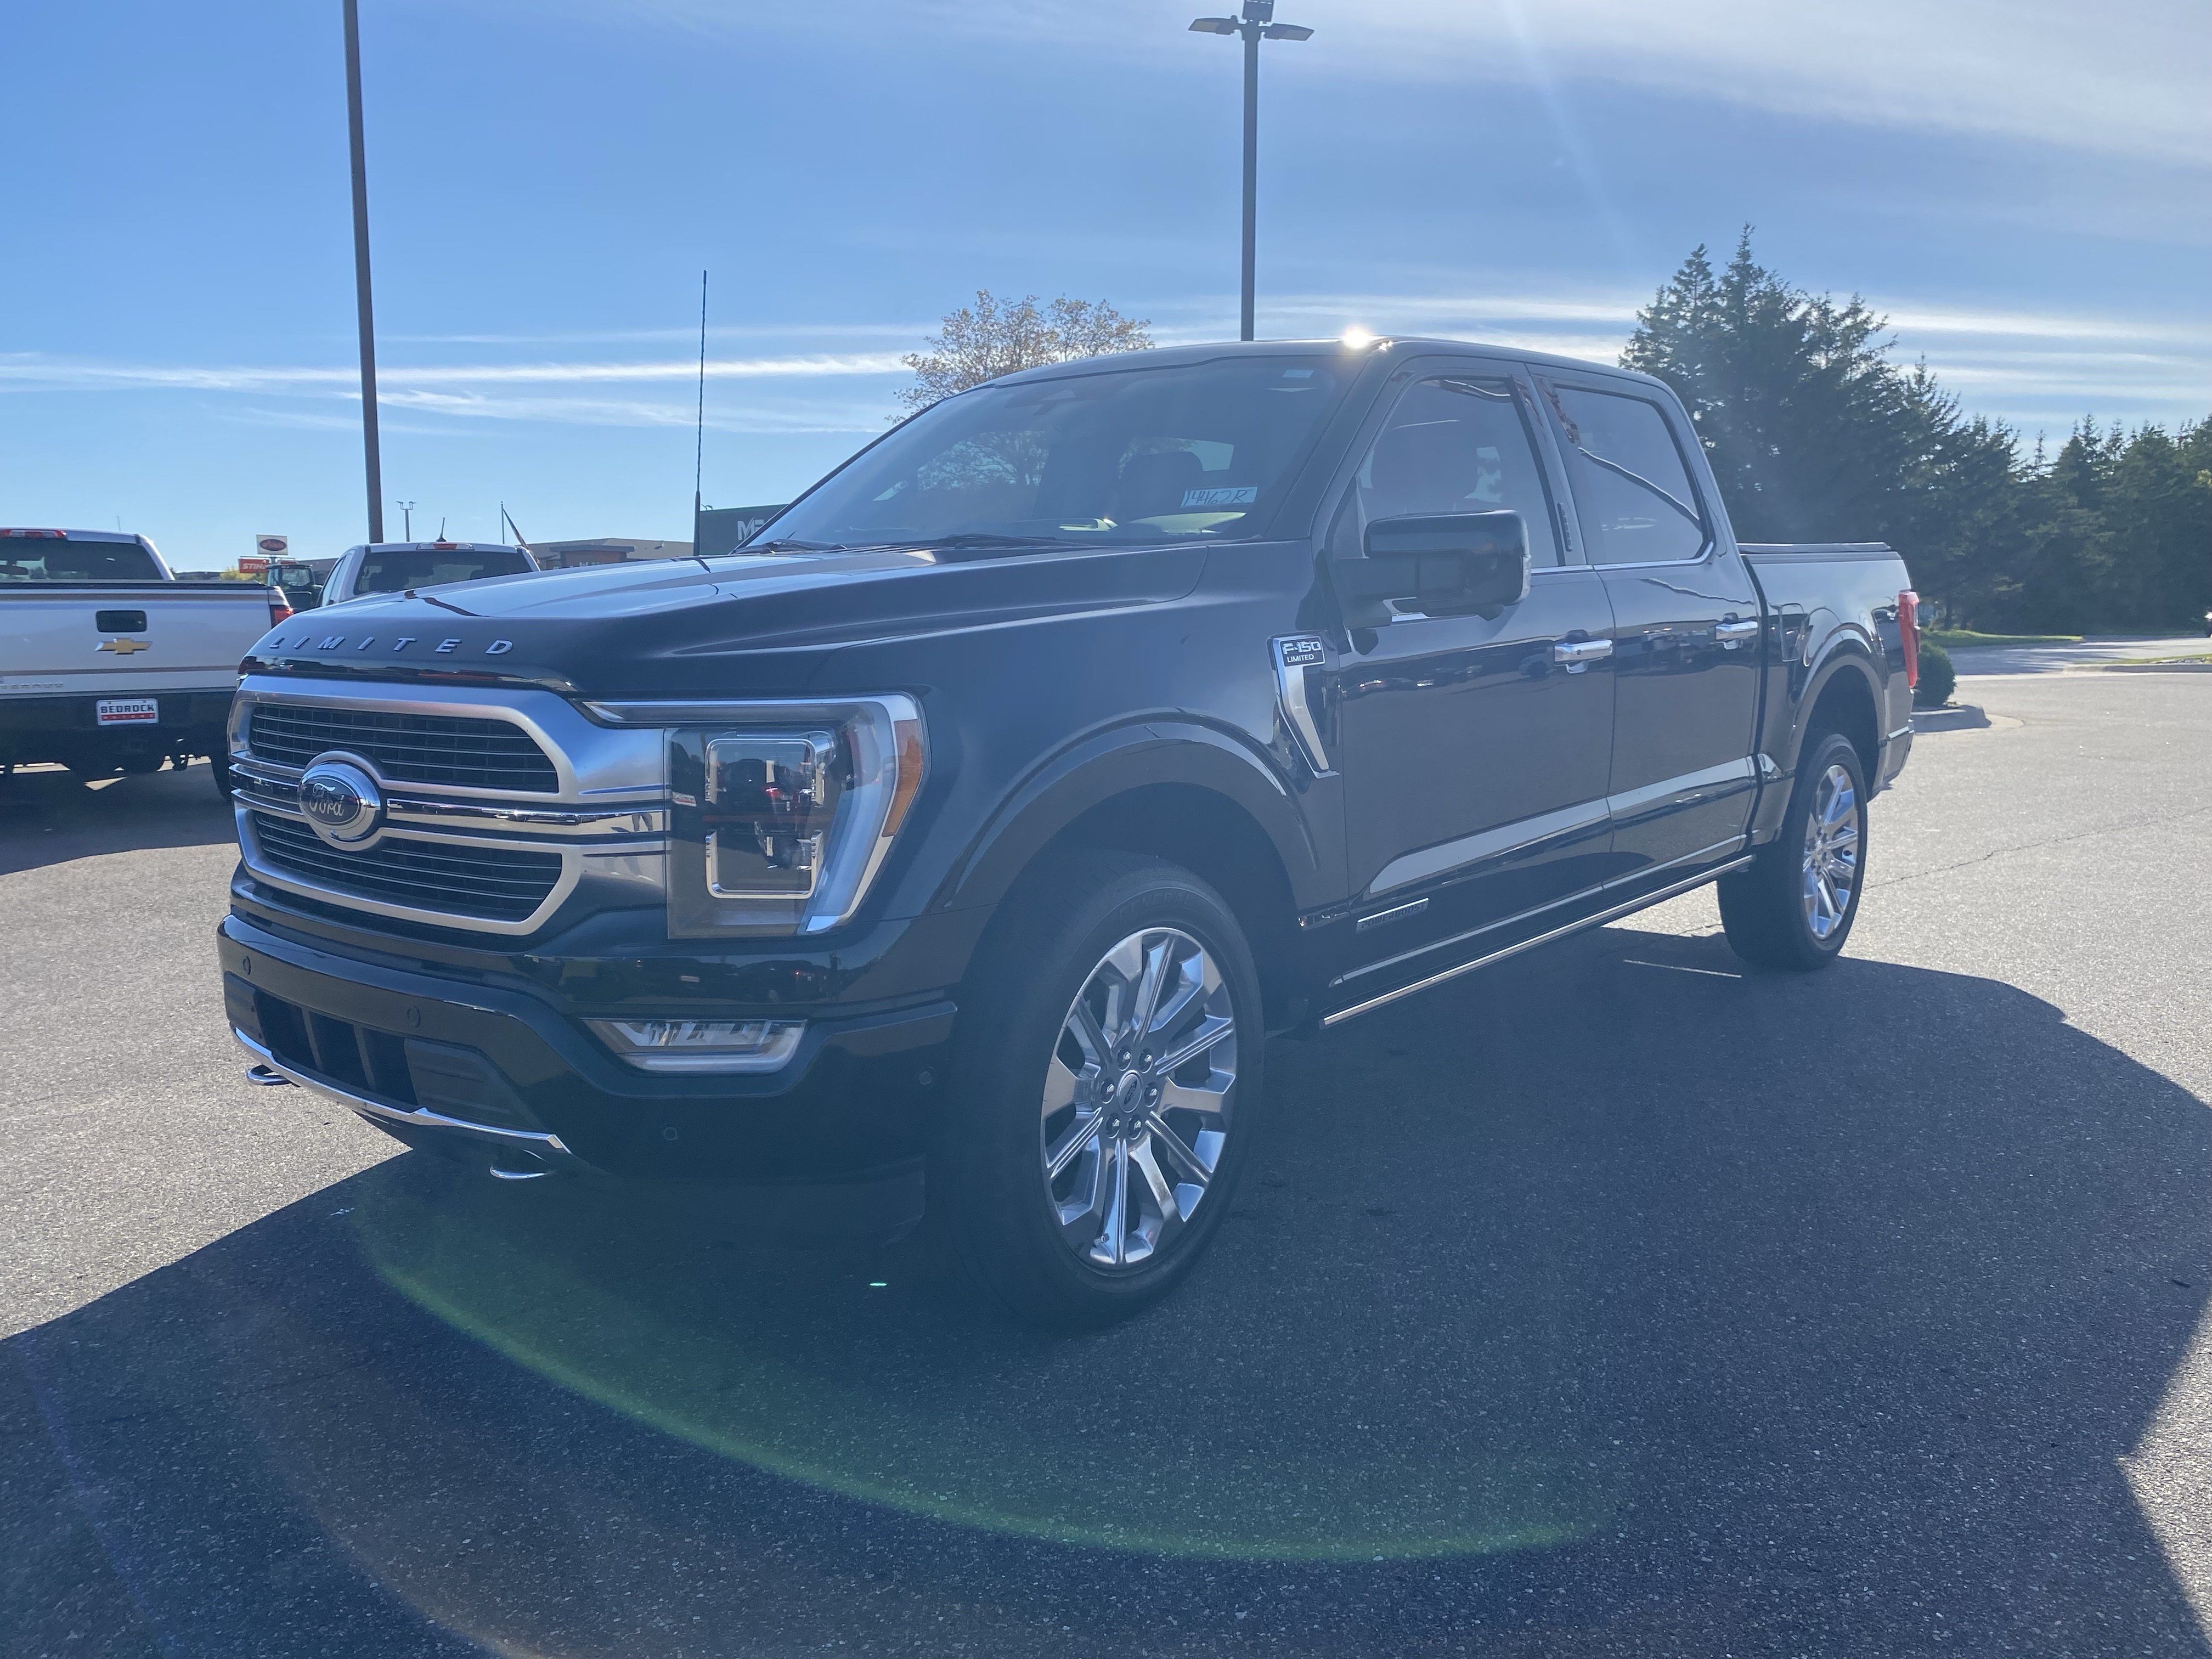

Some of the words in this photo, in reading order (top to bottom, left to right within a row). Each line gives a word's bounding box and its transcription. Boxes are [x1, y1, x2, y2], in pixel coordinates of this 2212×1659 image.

[269, 636, 513, 654] LIMITED
[1283, 641, 1322, 654] F-150
[1286, 653, 1314, 663] LIMITED
[100, 705, 154, 713] BEDROCK
[309, 783, 345, 817] Ford
[1361, 901, 1426, 929] POWERBOOST
